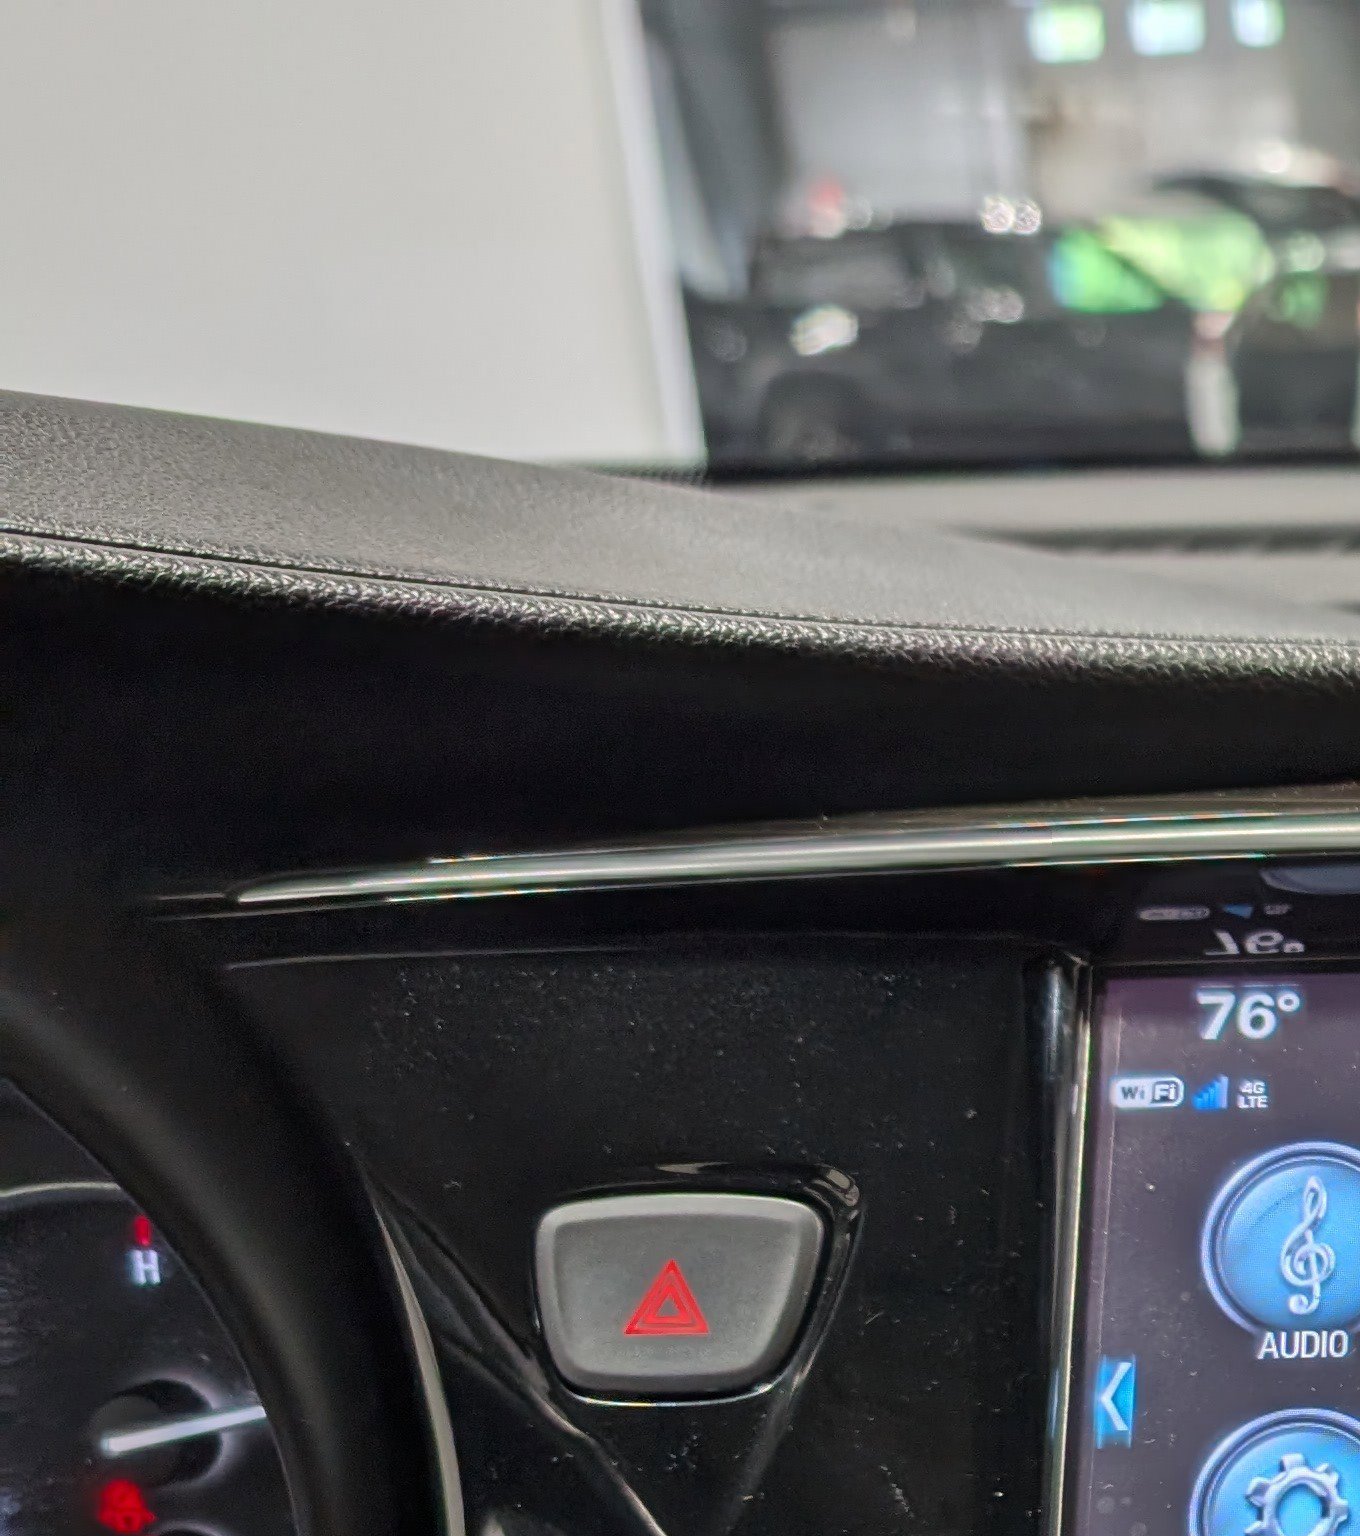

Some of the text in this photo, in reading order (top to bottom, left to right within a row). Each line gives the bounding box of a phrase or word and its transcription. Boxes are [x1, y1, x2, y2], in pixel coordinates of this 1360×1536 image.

[1196, 991, 1301, 1040] 76°
[1237, 1095, 1269, 1109] LTE
[1240, 1081, 1265, 1094] 4G
[130, 1249, 162, 1285] H
[1256, 1329, 1349, 1359] AUDIO
